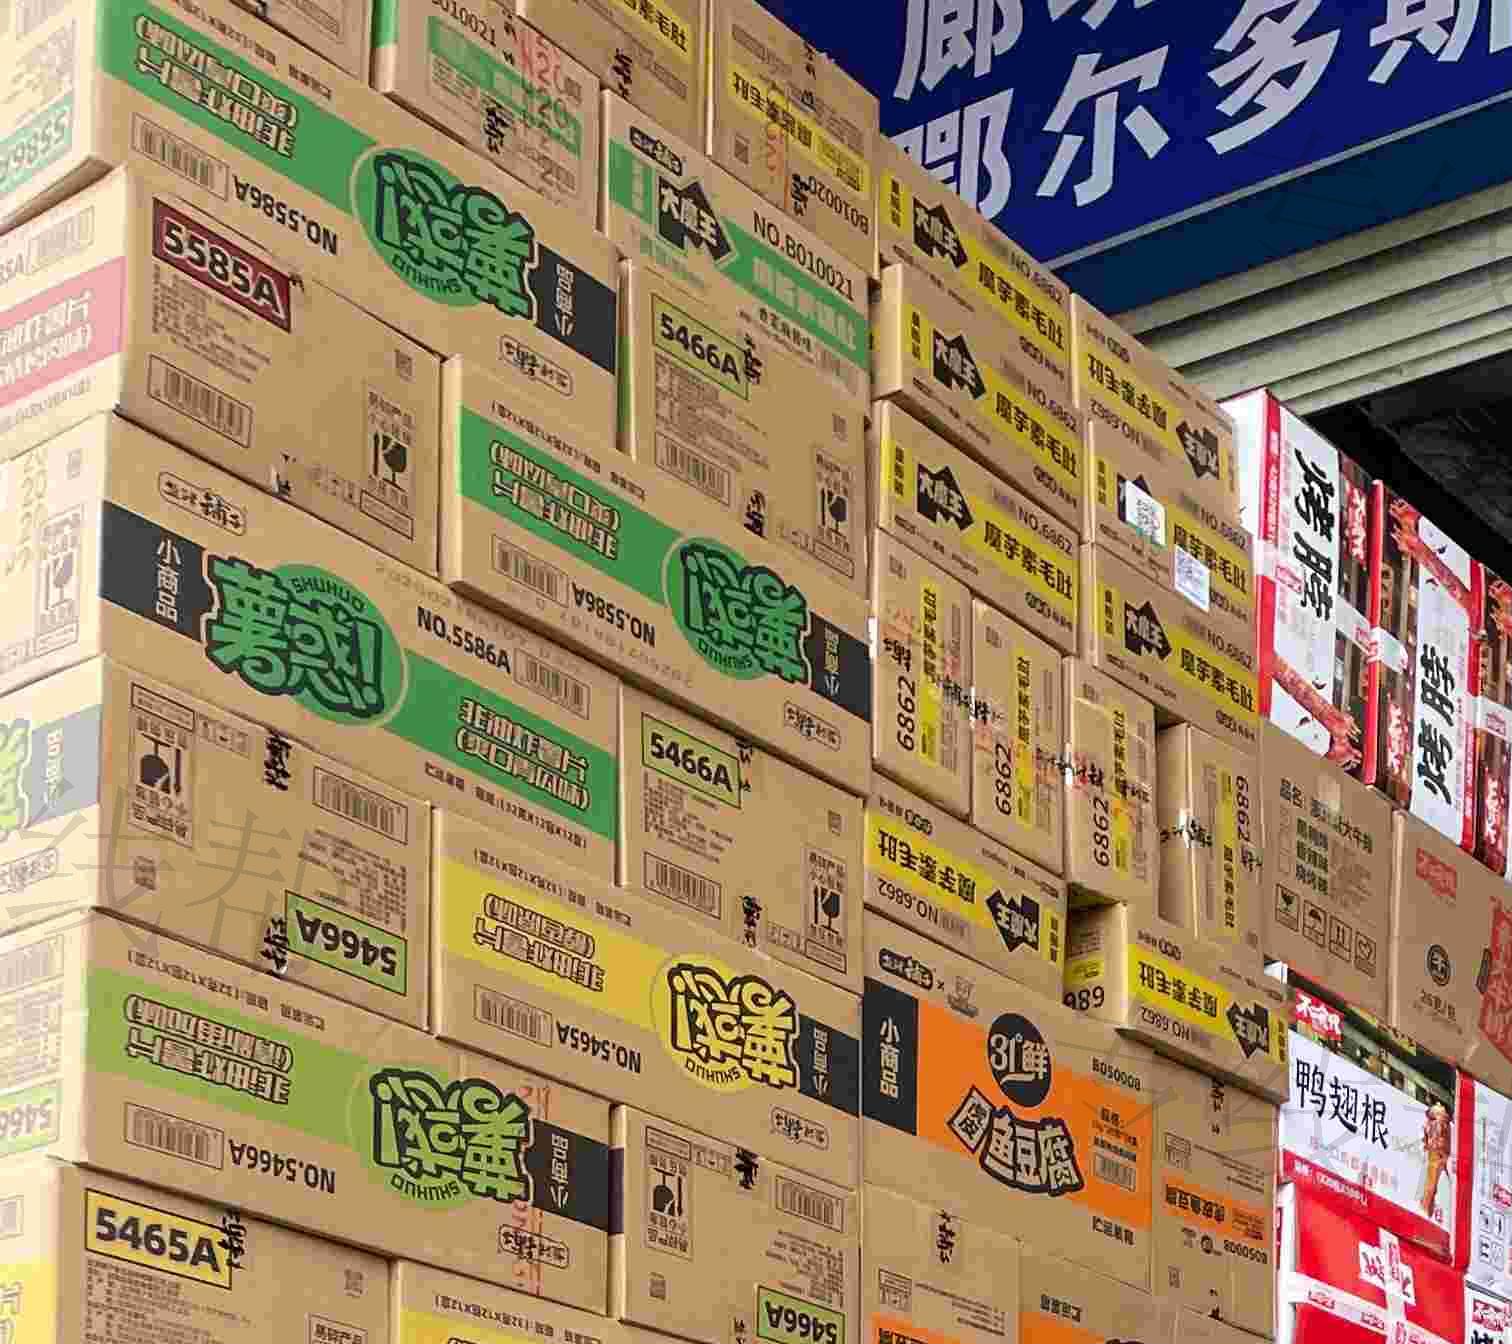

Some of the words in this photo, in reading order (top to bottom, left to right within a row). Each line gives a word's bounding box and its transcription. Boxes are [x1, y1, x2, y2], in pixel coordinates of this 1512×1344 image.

[232, 174, 339, 257] NO.5586A
[163, 222, 286, 321] 5585A
[752, 211, 857, 302] NO.B010021
[660, 313, 742, 383] 5466A
[994, 393, 1079, 478] 魔芋素毛肚
[983, 521, 1074, 600] 魔芋素毛肚
[1017, 509, 1074, 557] NO.6862
[155, 538, 180, 625] 小商品
[291, 576, 366, 613] SHUHUO
[571, 581, 657, 648] NO.5586A
[206, 556, 385, 718] 薯惑!
[416, 606, 512, 674] NO.5586A
[896, 676, 917, 752] 6862
[650, 731, 733, 793] 5466A
[995, 743, 1013, 818] 6862
[1093, 797, 1112, 867] 6862
[878, 877, 939, 927] NO.6862
[294, 910, 399, 976] 5466A
[557, 1020, 642, 1074] NO.5465A
[685, 1058, 741, 1084] SHUHUO
[880, 1015, 900, 1100] 小商品
[1295, 1058, 1389, 1149] 鸭翅根
[229, 1138, 336, 1194] NO.5466A
[390, 1172, 463, 1202] SHUHUO
[548, 1132, 571, 1208] 小商品
[95, 1206, 221, 1275] 5465A
